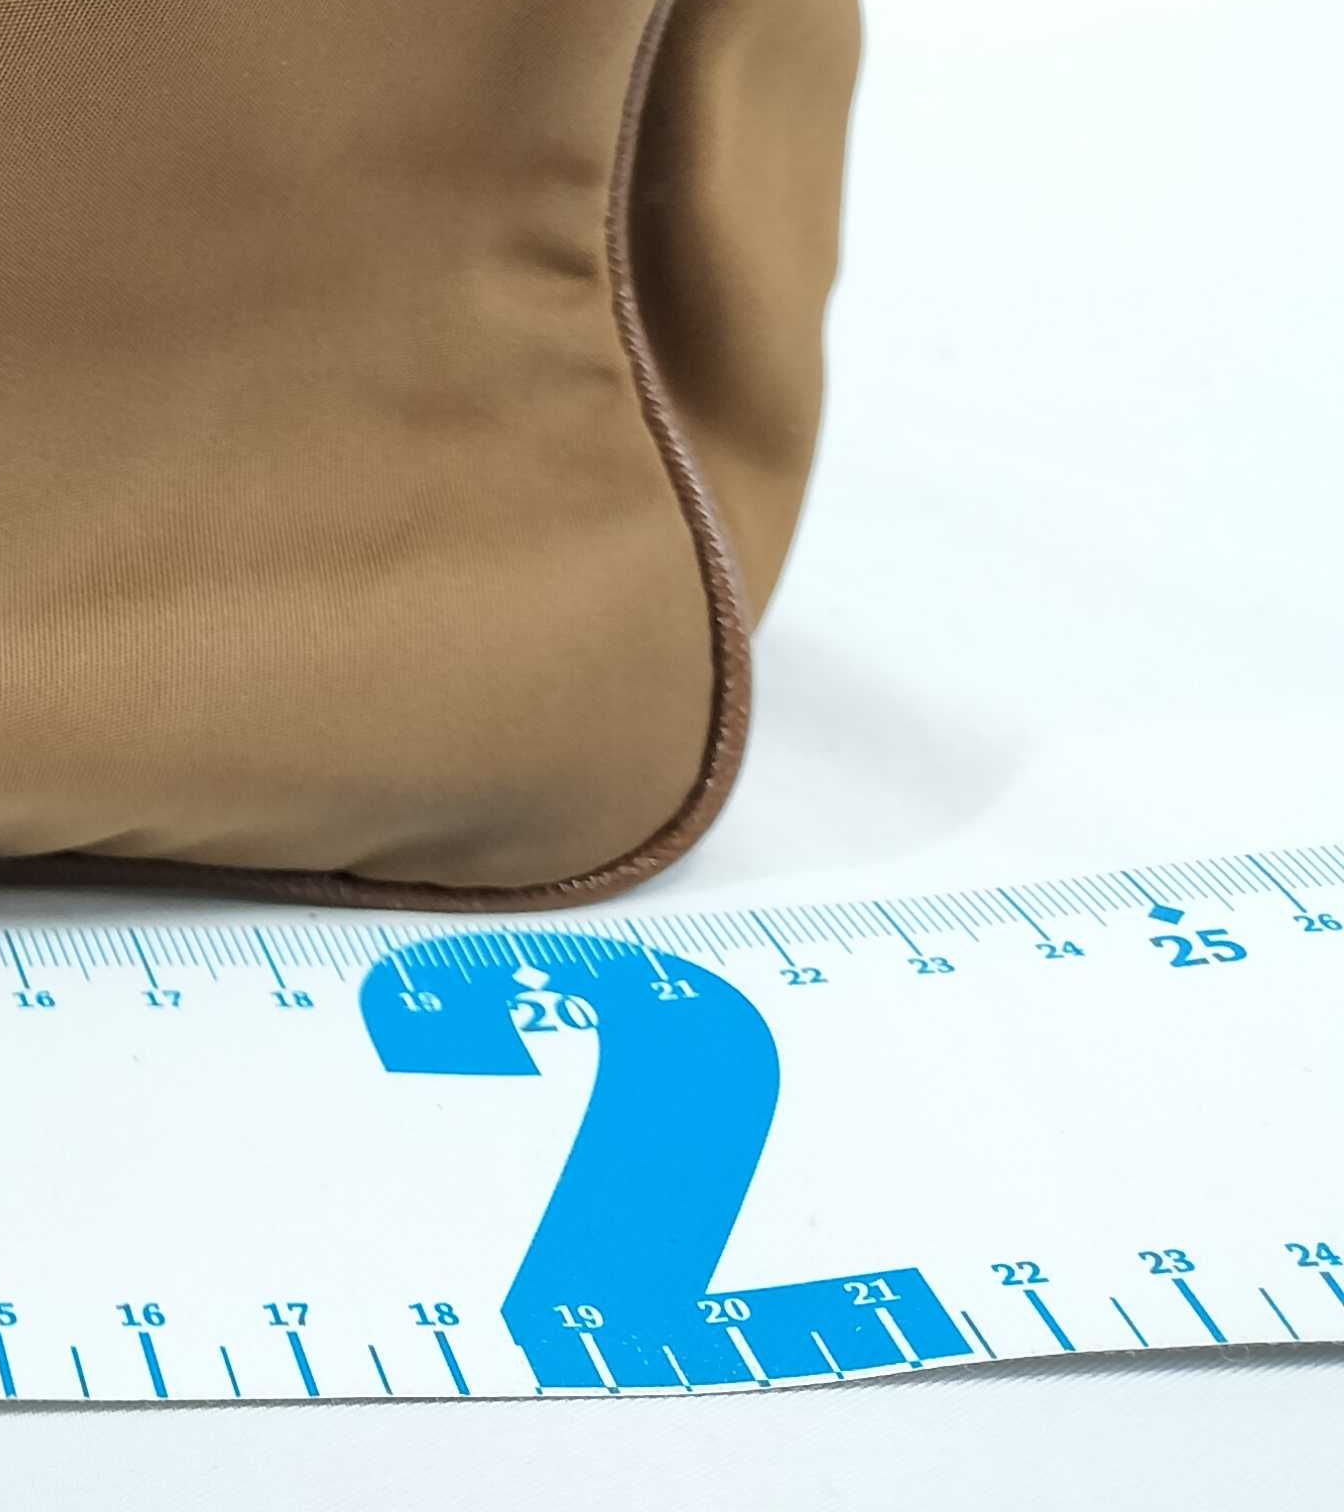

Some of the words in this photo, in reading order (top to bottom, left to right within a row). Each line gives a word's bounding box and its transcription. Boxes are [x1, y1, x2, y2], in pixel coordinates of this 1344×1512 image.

[14, 992, 56, 1009] 16
[143, 991, 183, 1007] 17
[271, 991, 313, 1008] 18
[398, 991, 443, 1014] 19
[507, 991, 599, 1033] 20
[650, 978, 700, 1001] 21
[780, 968, 828, 986] 22
[908, 957, 955, 975] 23
[1035, 940, 1085, 959] 24
[1149, 928, 1248, 968] 25
[1293, 913, 1343, 933] 26
[359, 931, 964, 1388] 2
[116, 1304, 166, 1327] 16
[262, 1304, 310, 1326] 17
[408, 1303, 460, 1327] 18
[553, 1303, 605, 1329] 19
[696, 1298, 752, 1323] 20
[842, 1279, 901, 1305] 21
[991, 1260, 1050, 1286] 22
[1137, 1249, 1196, 1274] 23
[1284, 1242, 1343, 1268] 24
